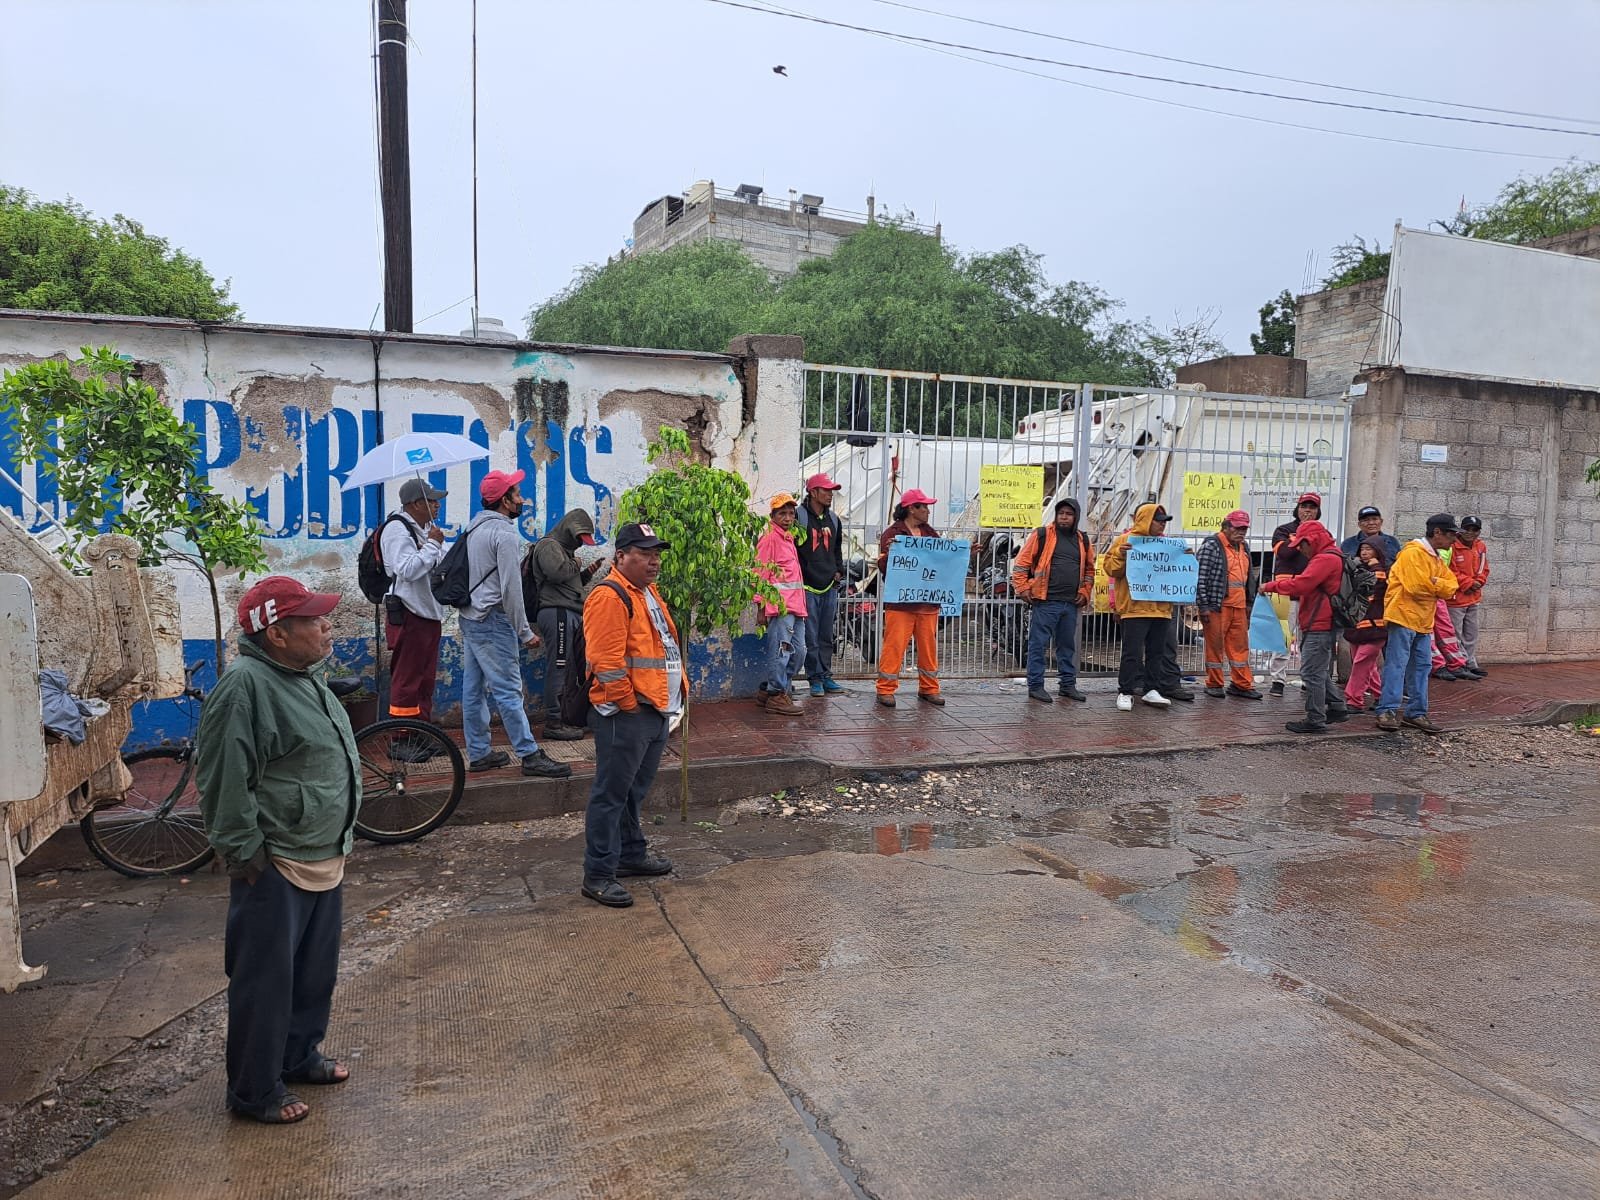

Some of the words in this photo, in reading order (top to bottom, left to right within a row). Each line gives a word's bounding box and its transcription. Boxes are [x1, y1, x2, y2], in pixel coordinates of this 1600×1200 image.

[1250, 464, 1331, 487] ACATLÁN
[1189, 474, 1200, 486] NO
[1207, 475, 1215, 487] A
[1221, 477, 1235, 490] LA
[1191, 516, 1226, 527] LABOR
[892, 556, 919, 568] PAGO
[1130, 552, 1170, 562] AUMENTO
[922, 568, 937, 579] DE
[1153, 564, 1193, 572] SALARIAL
[1160, 583, 1197, 595] MEDICO
[898, 588, 955, 604] DESPENSAS
